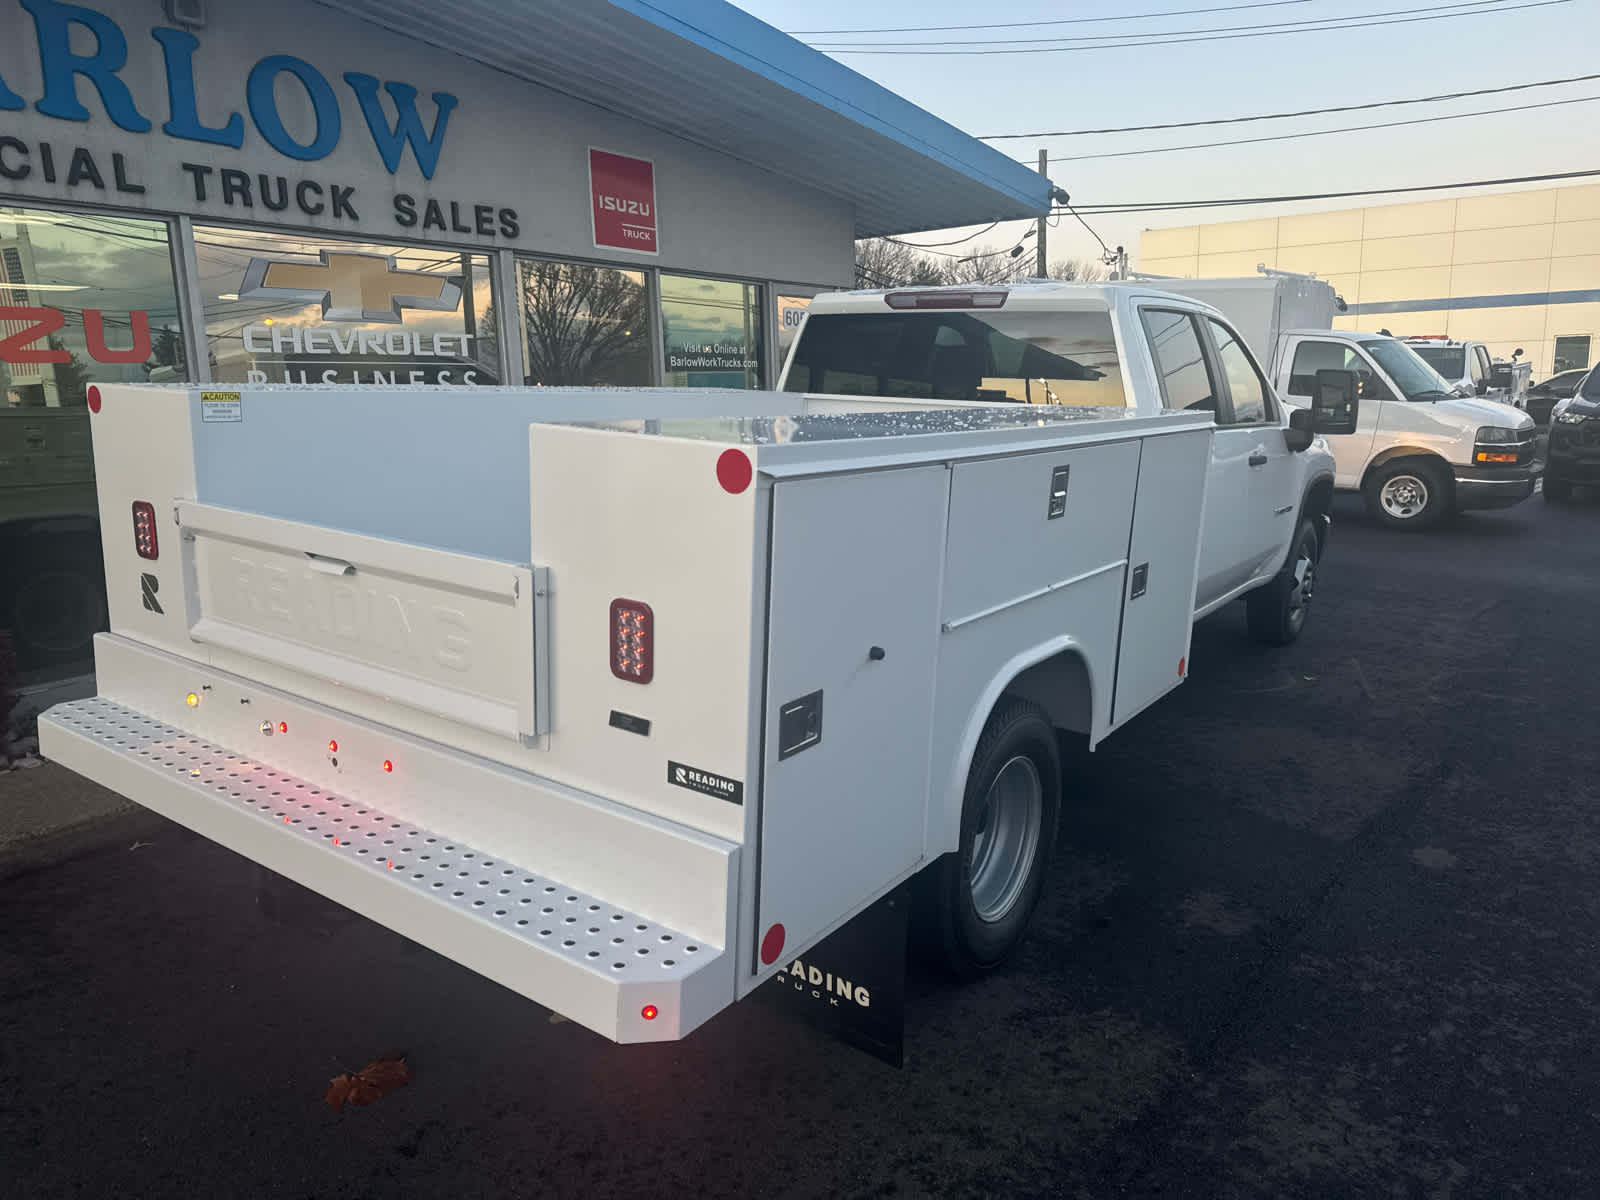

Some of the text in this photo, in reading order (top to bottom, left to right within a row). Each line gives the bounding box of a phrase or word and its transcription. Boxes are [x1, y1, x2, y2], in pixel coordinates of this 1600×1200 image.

[0, 0, 458, 180] RLOW
[182, 162, 360, 220] TRUCK
[394, 193, 521, 239] SALES
[599, 194, 650, 216] ISUZU
[622, 229, 650, 240] TRUCK
[242, 326, 474, 357] CHEVROLET
[683, 343, 701, 353] Visit
[713, 343, 738, 354] Online
[670, 356, 758, 369] BarlowWorkTrucks.com
[209, 392, 241, 401] CAUTION
[688, 770, 735, 793] READING
[781, 959, 871, 1008] ADING
